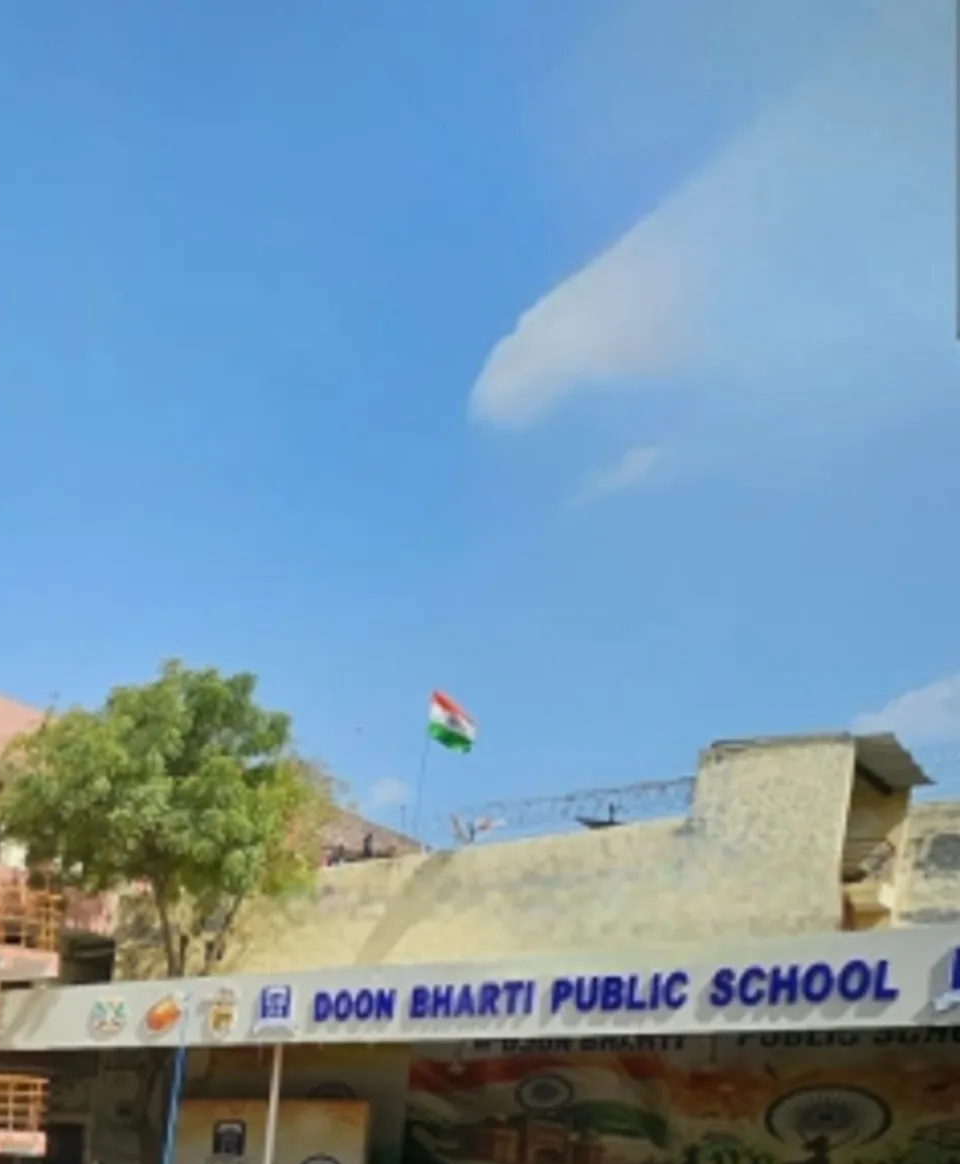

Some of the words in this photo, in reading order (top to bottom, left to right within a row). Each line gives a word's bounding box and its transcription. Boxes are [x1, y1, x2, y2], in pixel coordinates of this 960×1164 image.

[313, 987, 397, 1022] DOON
[409, 979, 537, 1019] BHARTI
[551, 970, 689, 1014] PUBLIC
[708, 959, 900, 1007] SCHOOL
